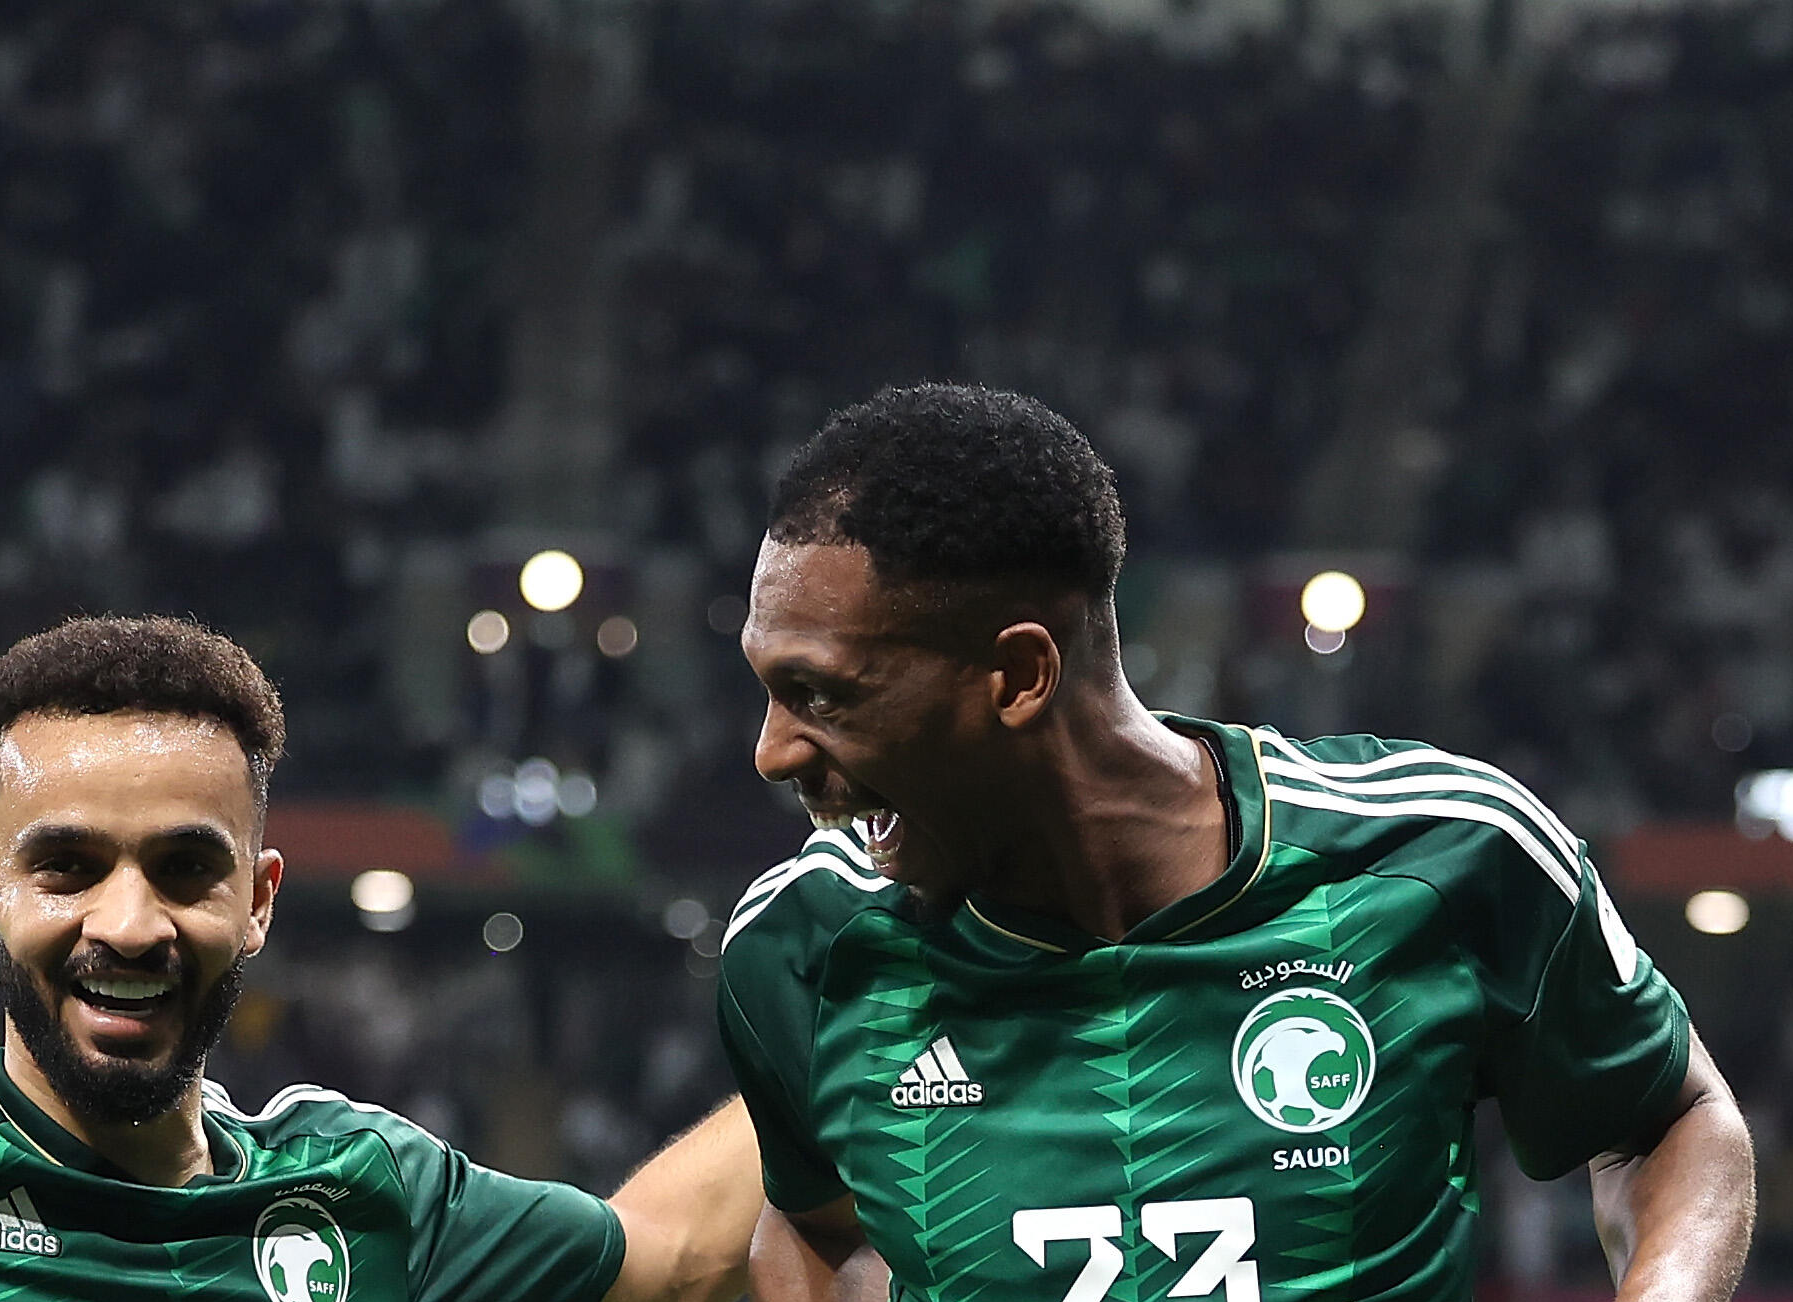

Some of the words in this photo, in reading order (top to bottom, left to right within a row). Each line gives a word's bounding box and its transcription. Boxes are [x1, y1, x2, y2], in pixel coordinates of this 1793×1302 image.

[1238, 959, 1355, 990] السعودية
[890, 1079, 983, 1106] adidas
[1310, 1073, 1351, 1089] SAFF
[1272, 1146, 1350, 1170] SAUDI
[309, 1280, 335, 1295] SAFF
